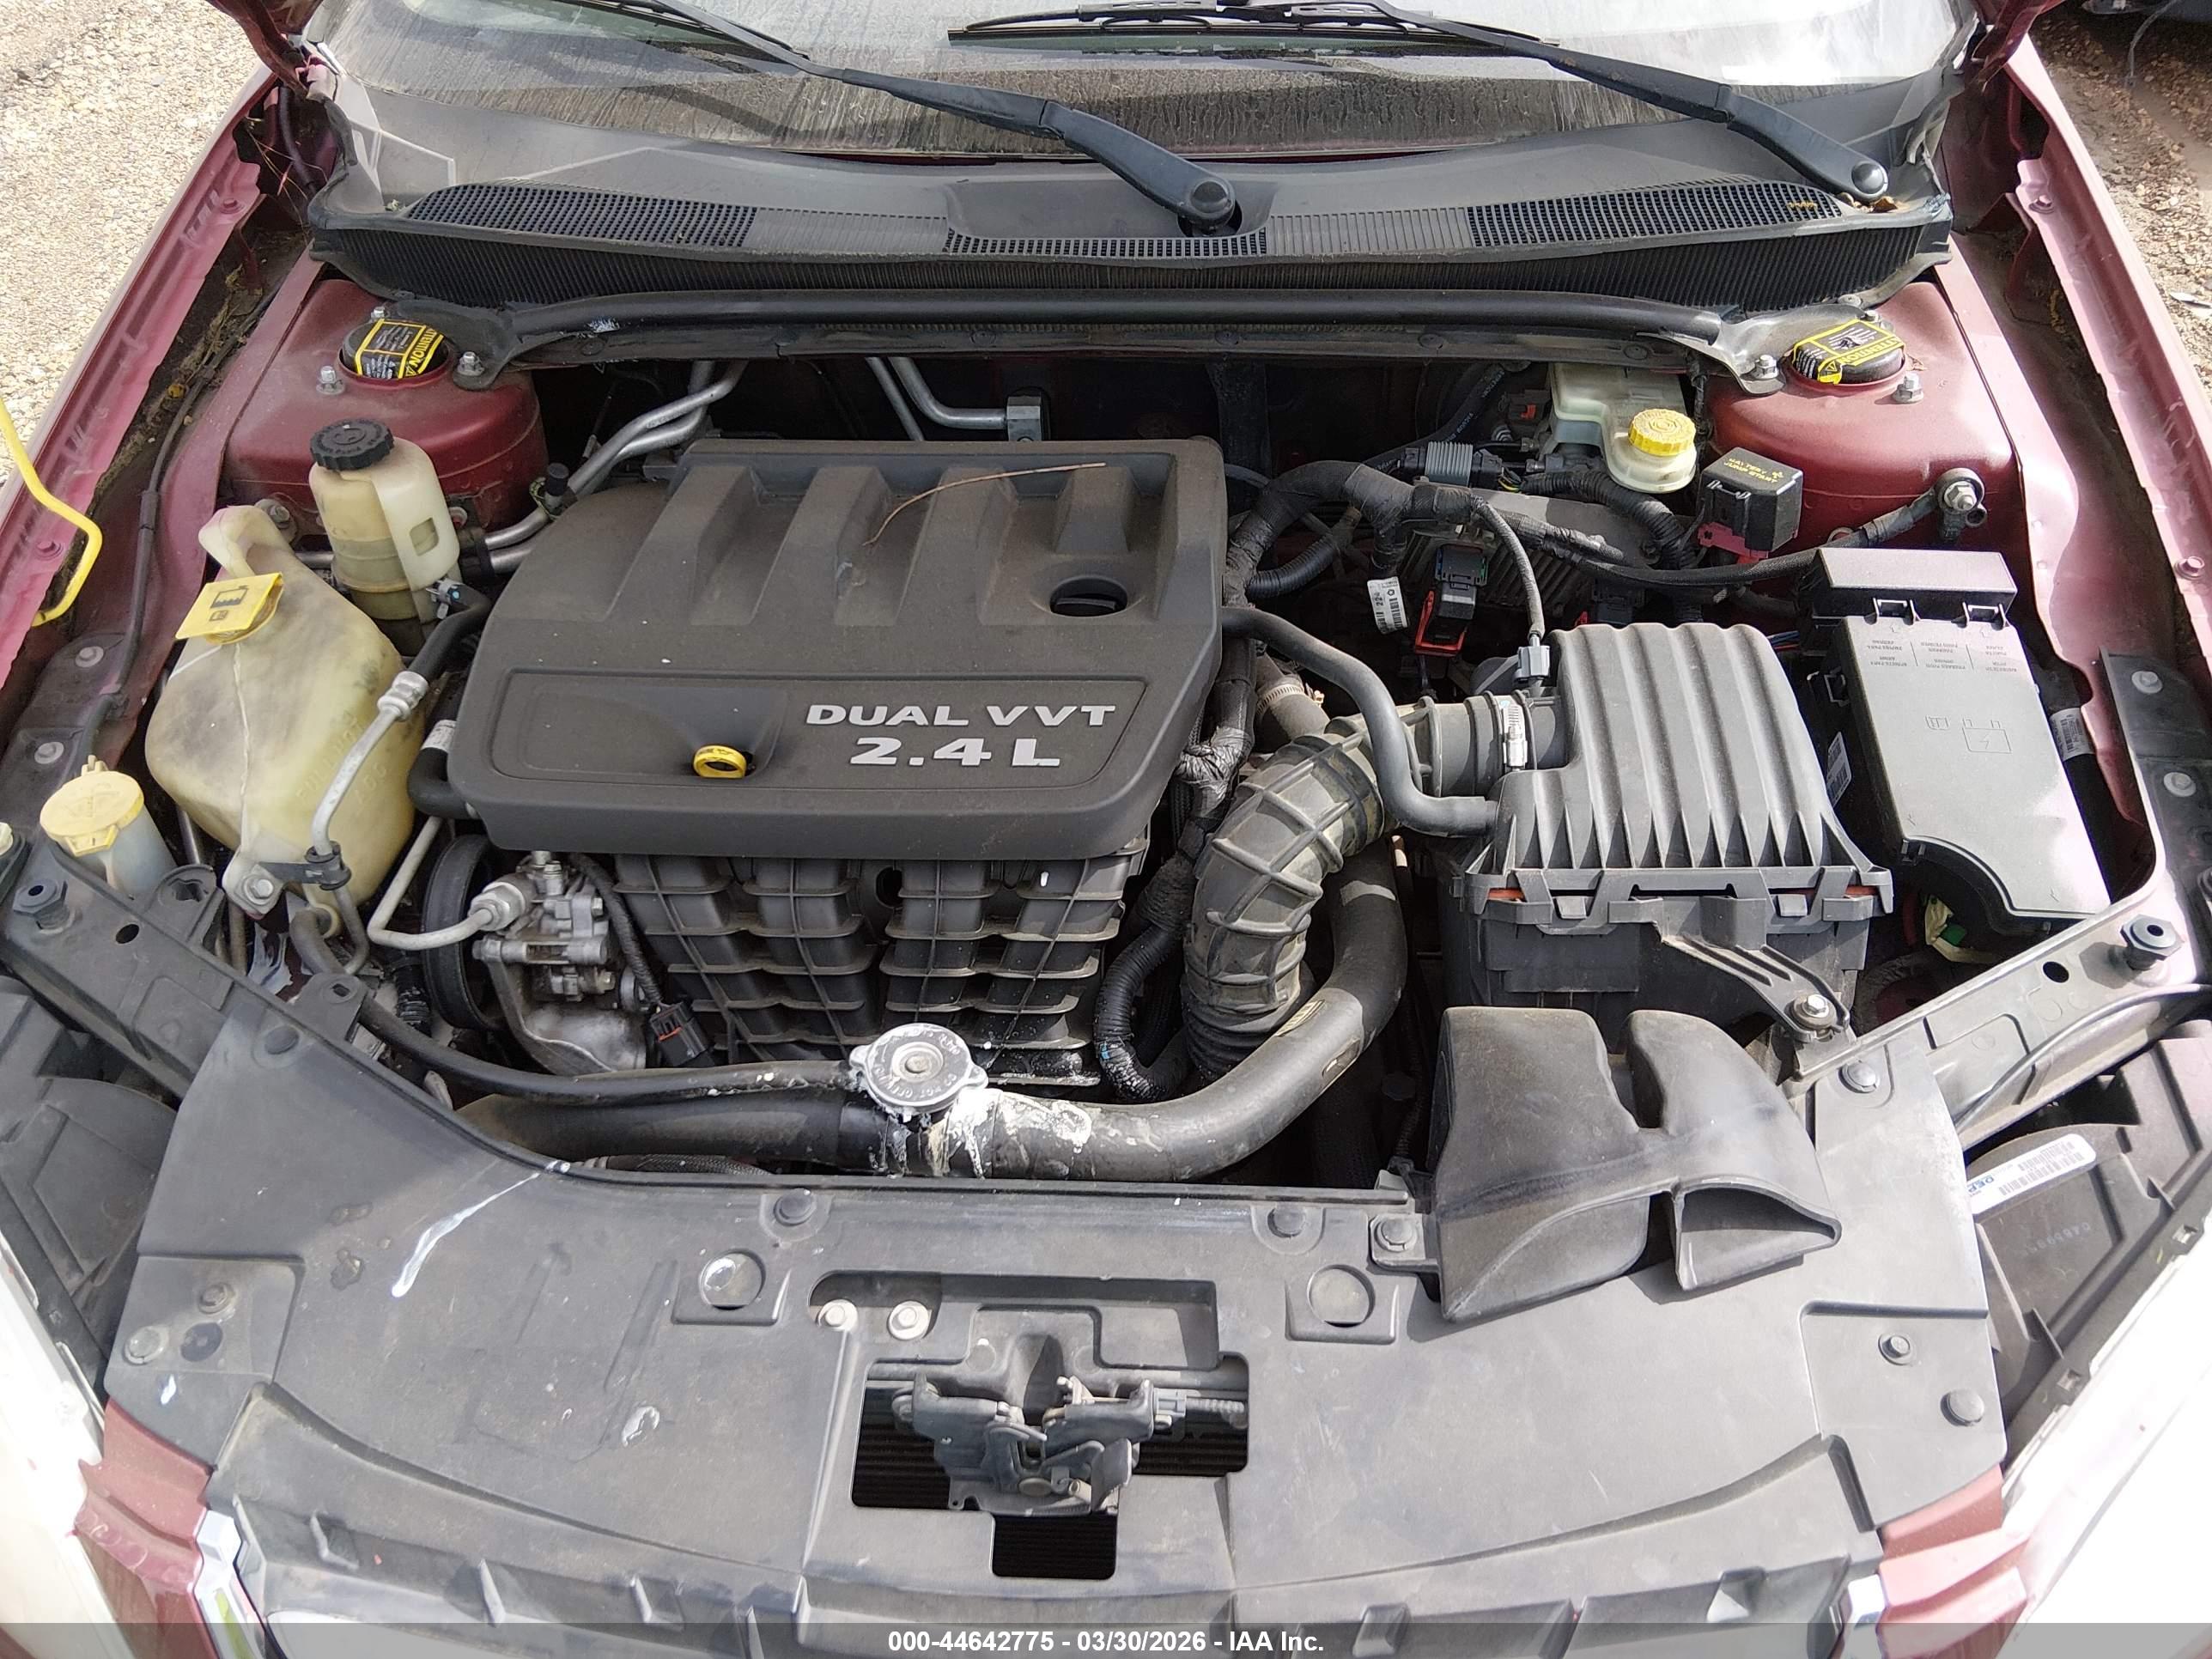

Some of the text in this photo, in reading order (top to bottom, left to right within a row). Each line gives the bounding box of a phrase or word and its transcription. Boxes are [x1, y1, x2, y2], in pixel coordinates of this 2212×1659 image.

[1723, 462, 1748, 472] JUMP
[1748, 470, 1779, 484] START
[805, 704, 1116, 727] DUAL VVT
[1966, 1175, 1994, 1193] DEP
